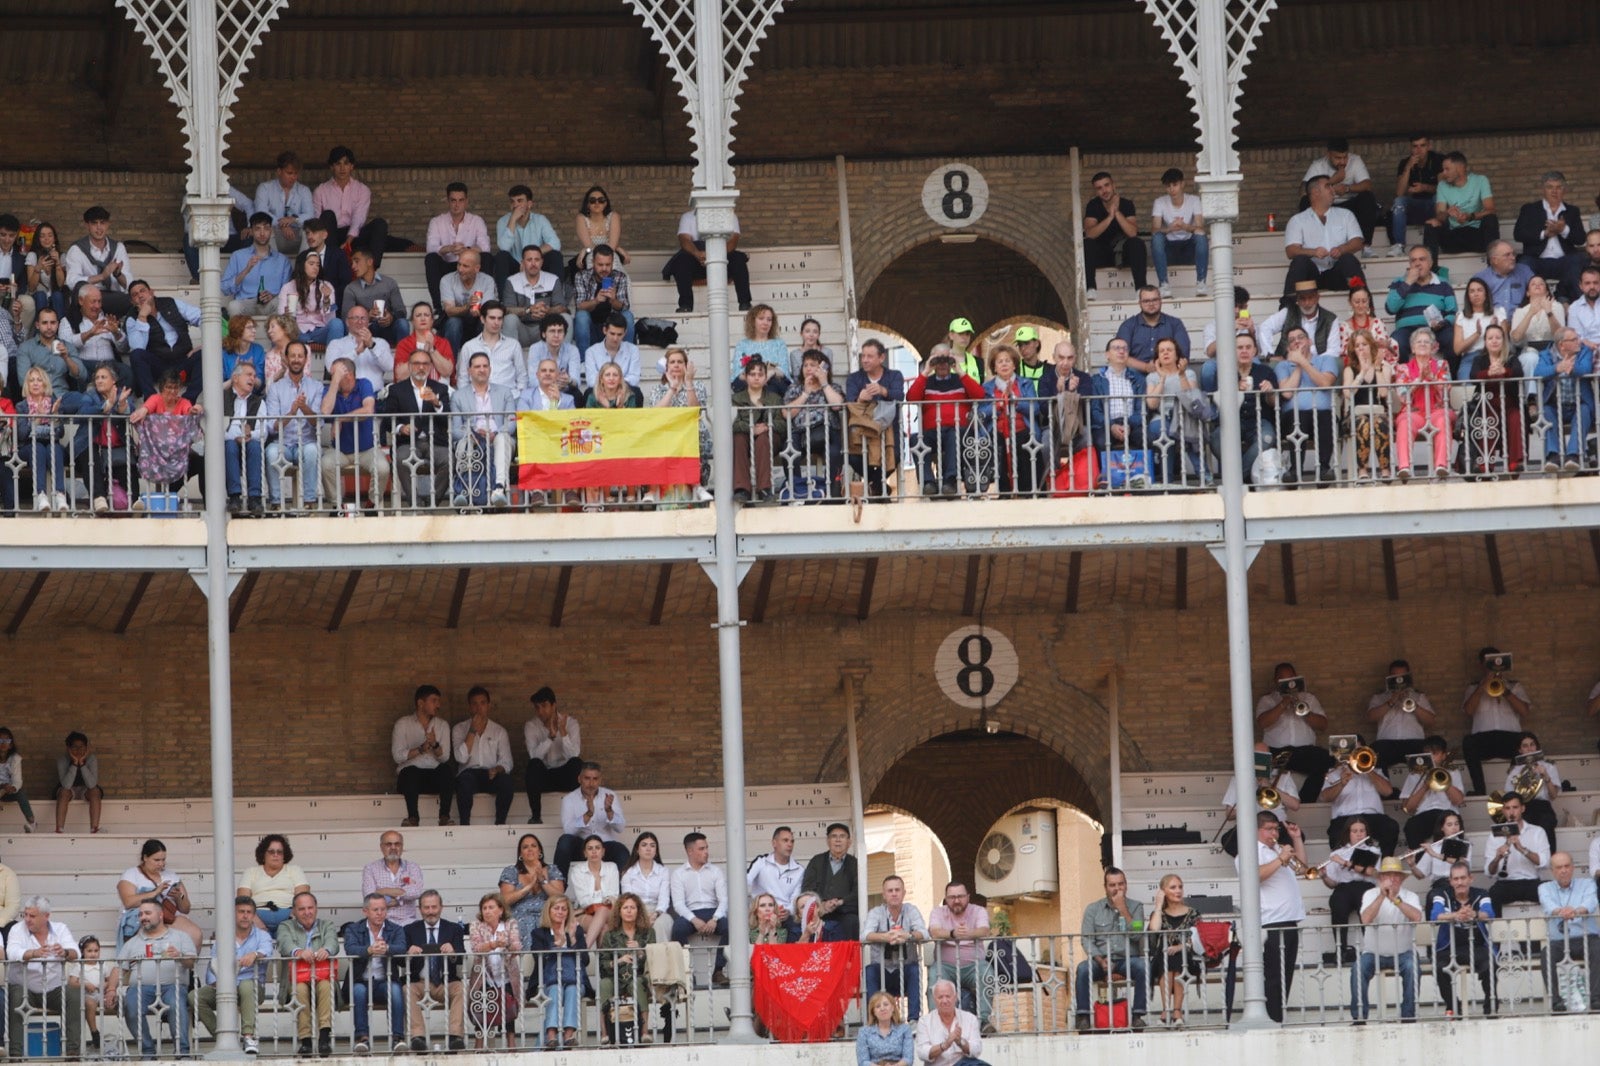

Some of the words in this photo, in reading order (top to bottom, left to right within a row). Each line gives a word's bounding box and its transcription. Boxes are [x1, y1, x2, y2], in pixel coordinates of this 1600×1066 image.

[942, 170, 973, 219] 8
[799, 261, 806, 269] 6
[957, 634, 994, 697] 8
